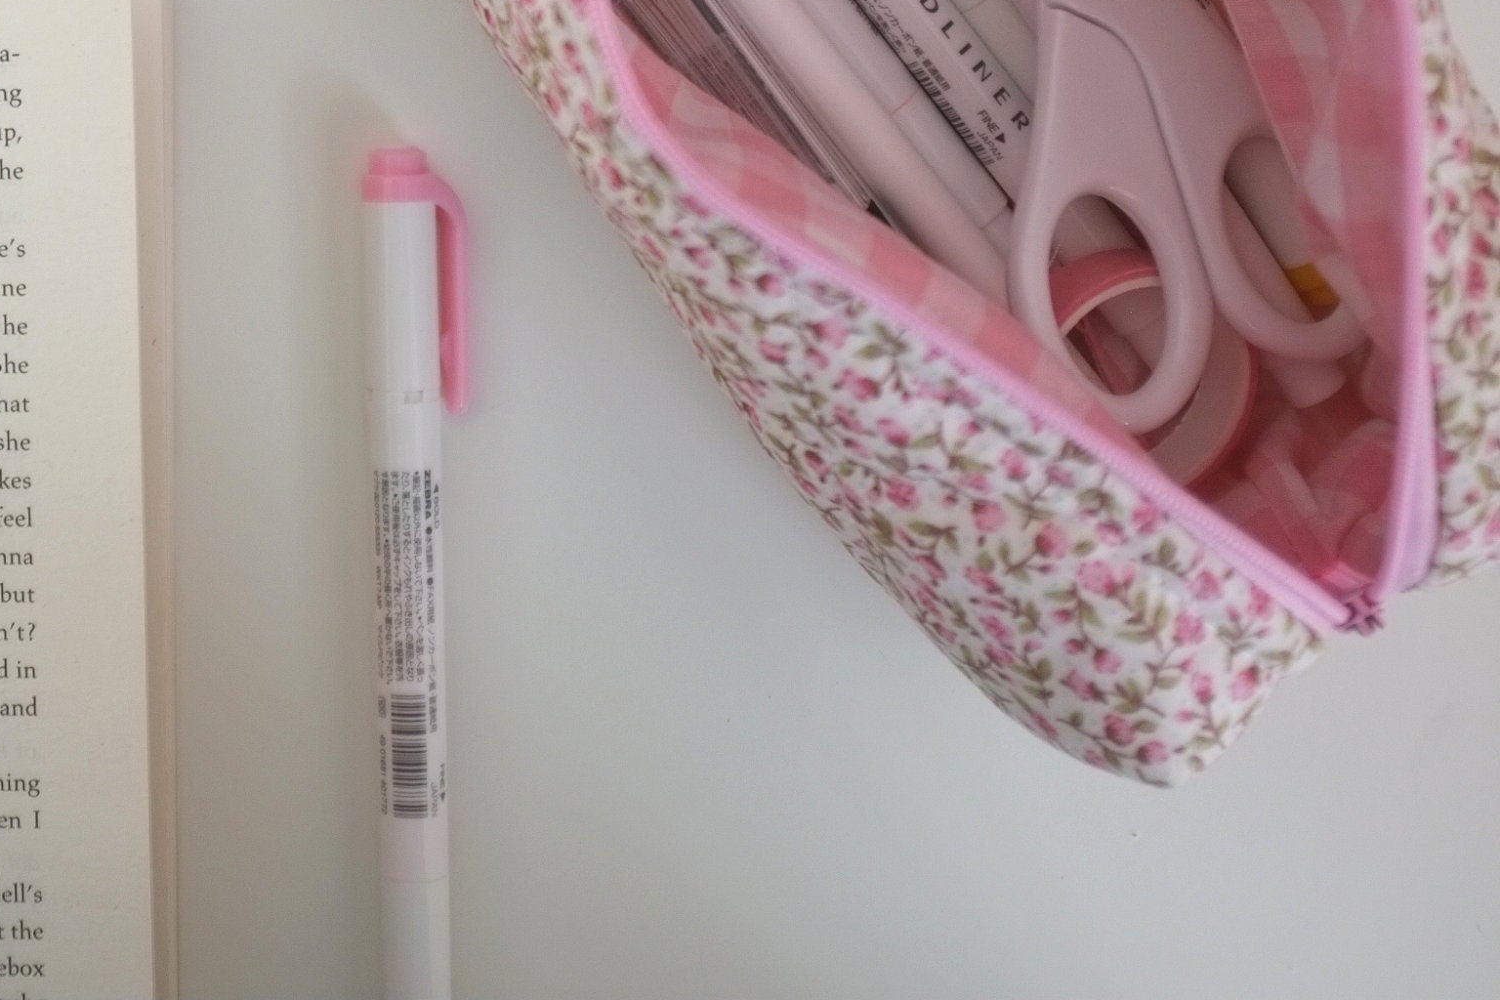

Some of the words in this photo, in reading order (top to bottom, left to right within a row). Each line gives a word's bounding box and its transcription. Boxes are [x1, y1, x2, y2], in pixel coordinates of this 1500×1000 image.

[975, 108, 1000, 134] FINE
[976, 128, 1004, 162] JAPAN
[16, 660, 37, 680] in
